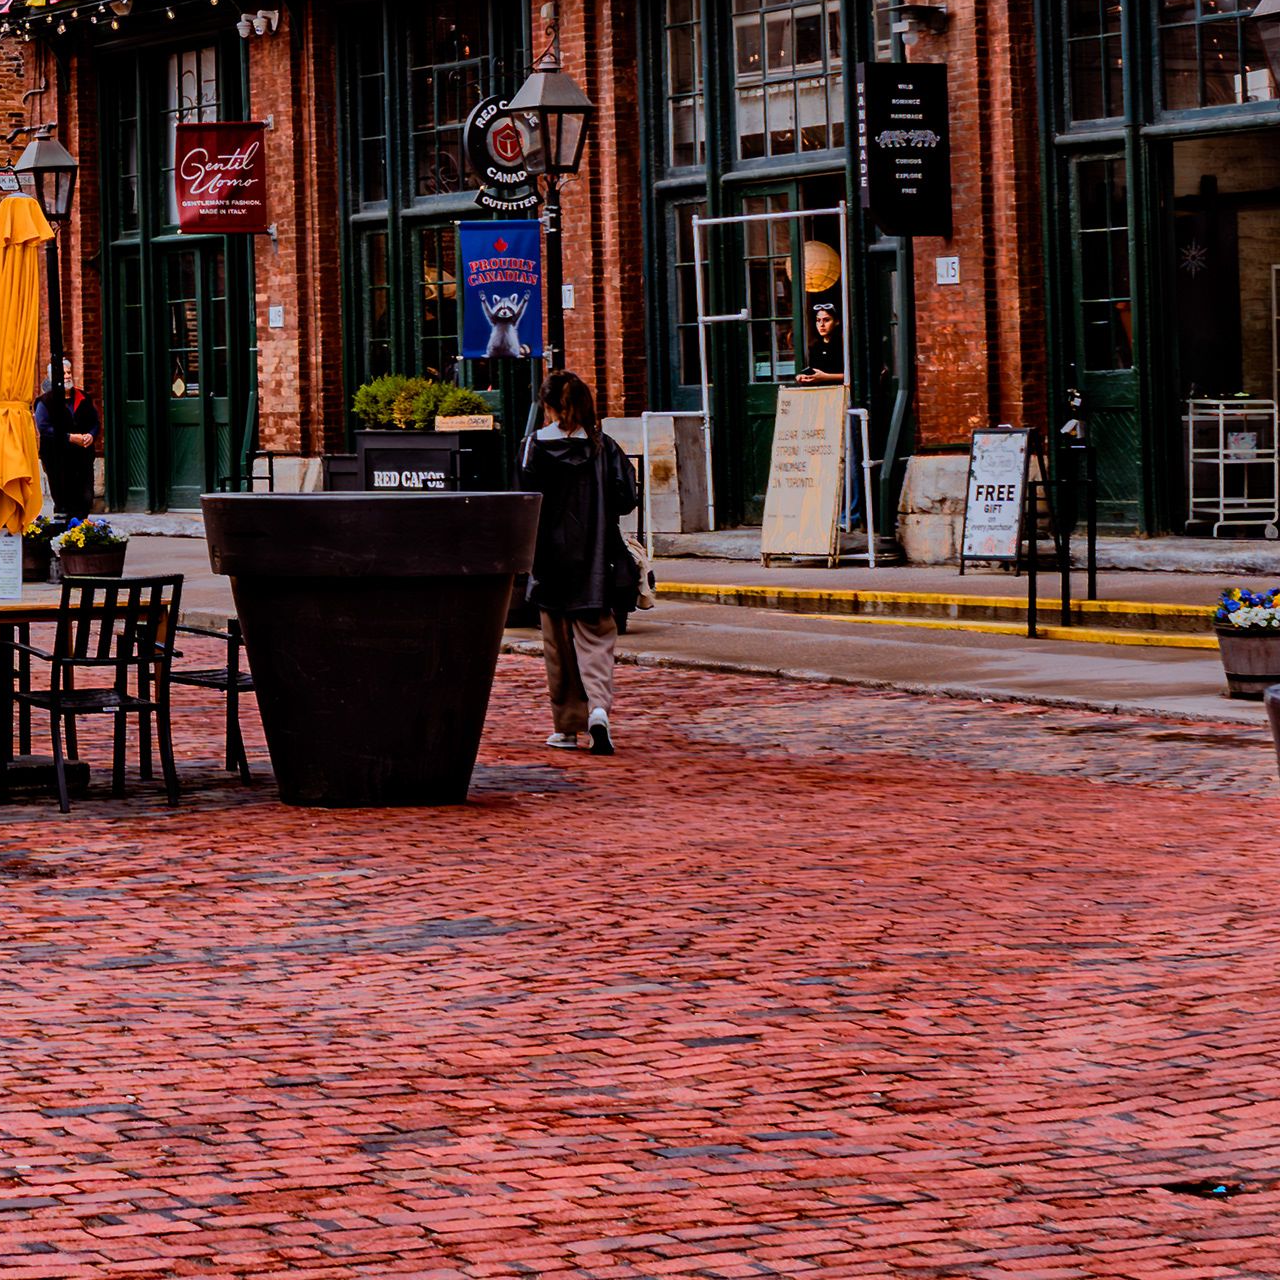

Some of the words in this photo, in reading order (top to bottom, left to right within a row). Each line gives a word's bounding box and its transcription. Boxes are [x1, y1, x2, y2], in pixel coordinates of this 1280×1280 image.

[475, 104, 498, 129] RED
[857, 82, 868, 187] HANDMADE
[180, 141, 260, 180] Gentil
[190, 163, 259, 194] Uomo
[486, 167, 528, 183] CANAD
[468, 258, 536, 274] PROUDLY
[945, 261, 957, 278] 15
[468, 270, 539, 287] CANADIAN
[776, 446, 800, 457] STRONG
[373, 471, 400, 487] RED
[772, 478, 781, 489] IN
[975, 484, 1016, 502] FREE
[984, 504, 1003, 514] GIFT
[971, 524, 987, 532] every
[987, 523, 1013, 532] purchase
